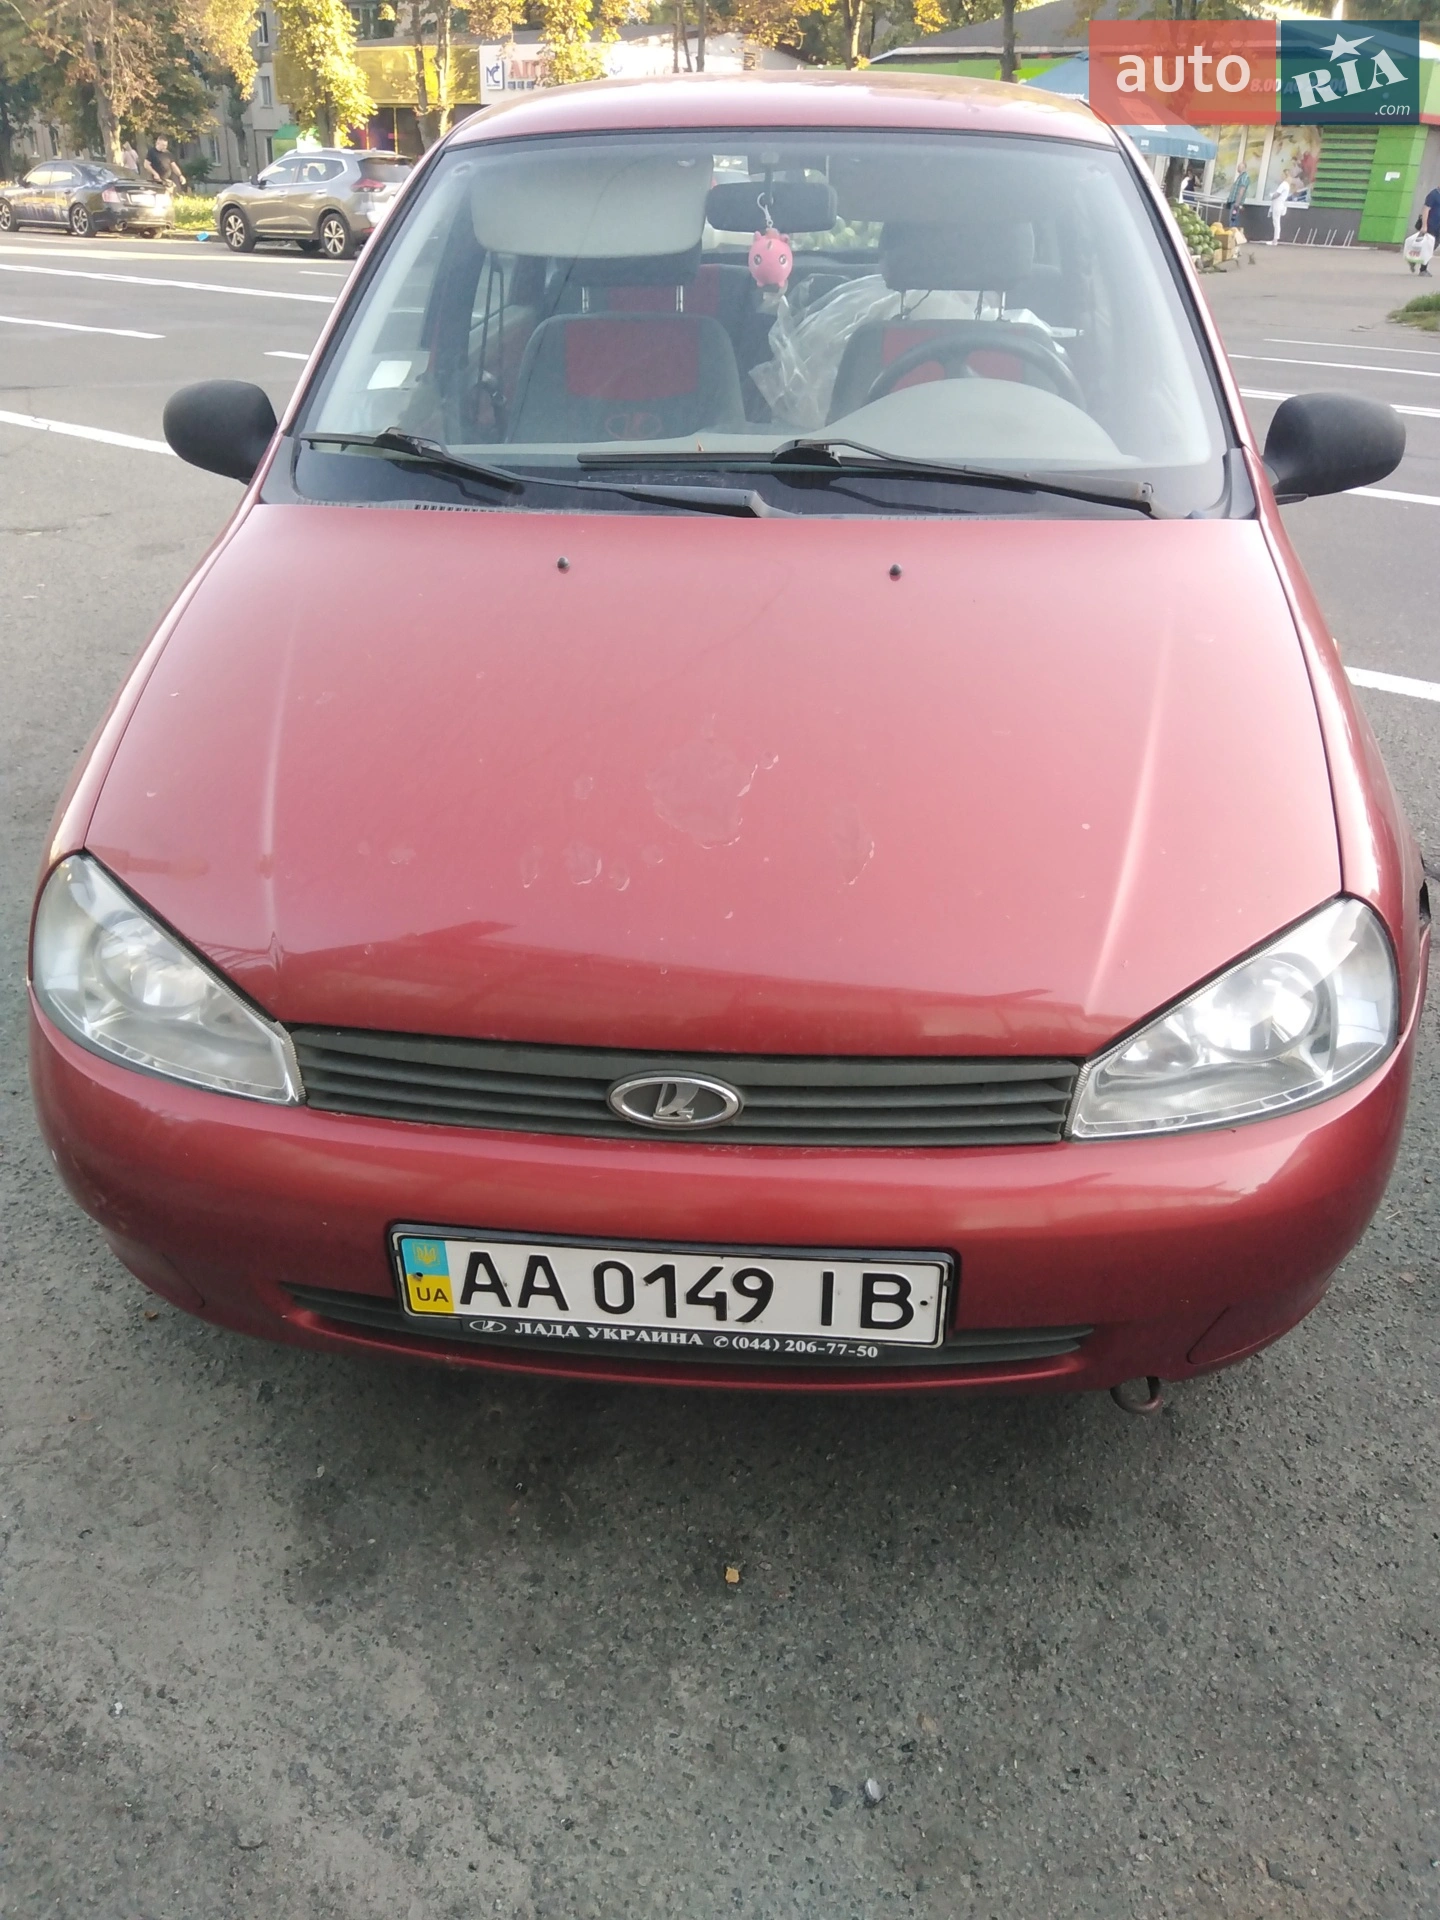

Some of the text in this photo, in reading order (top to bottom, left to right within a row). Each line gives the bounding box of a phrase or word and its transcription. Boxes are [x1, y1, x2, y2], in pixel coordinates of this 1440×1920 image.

[416, 1287, 449, 1303] UA
[460, 1251, 915, 1330] AA 0149 IB
[514, 1322, 879, 1359] ЛАДА УКРАИНА (044) 206-77-50
